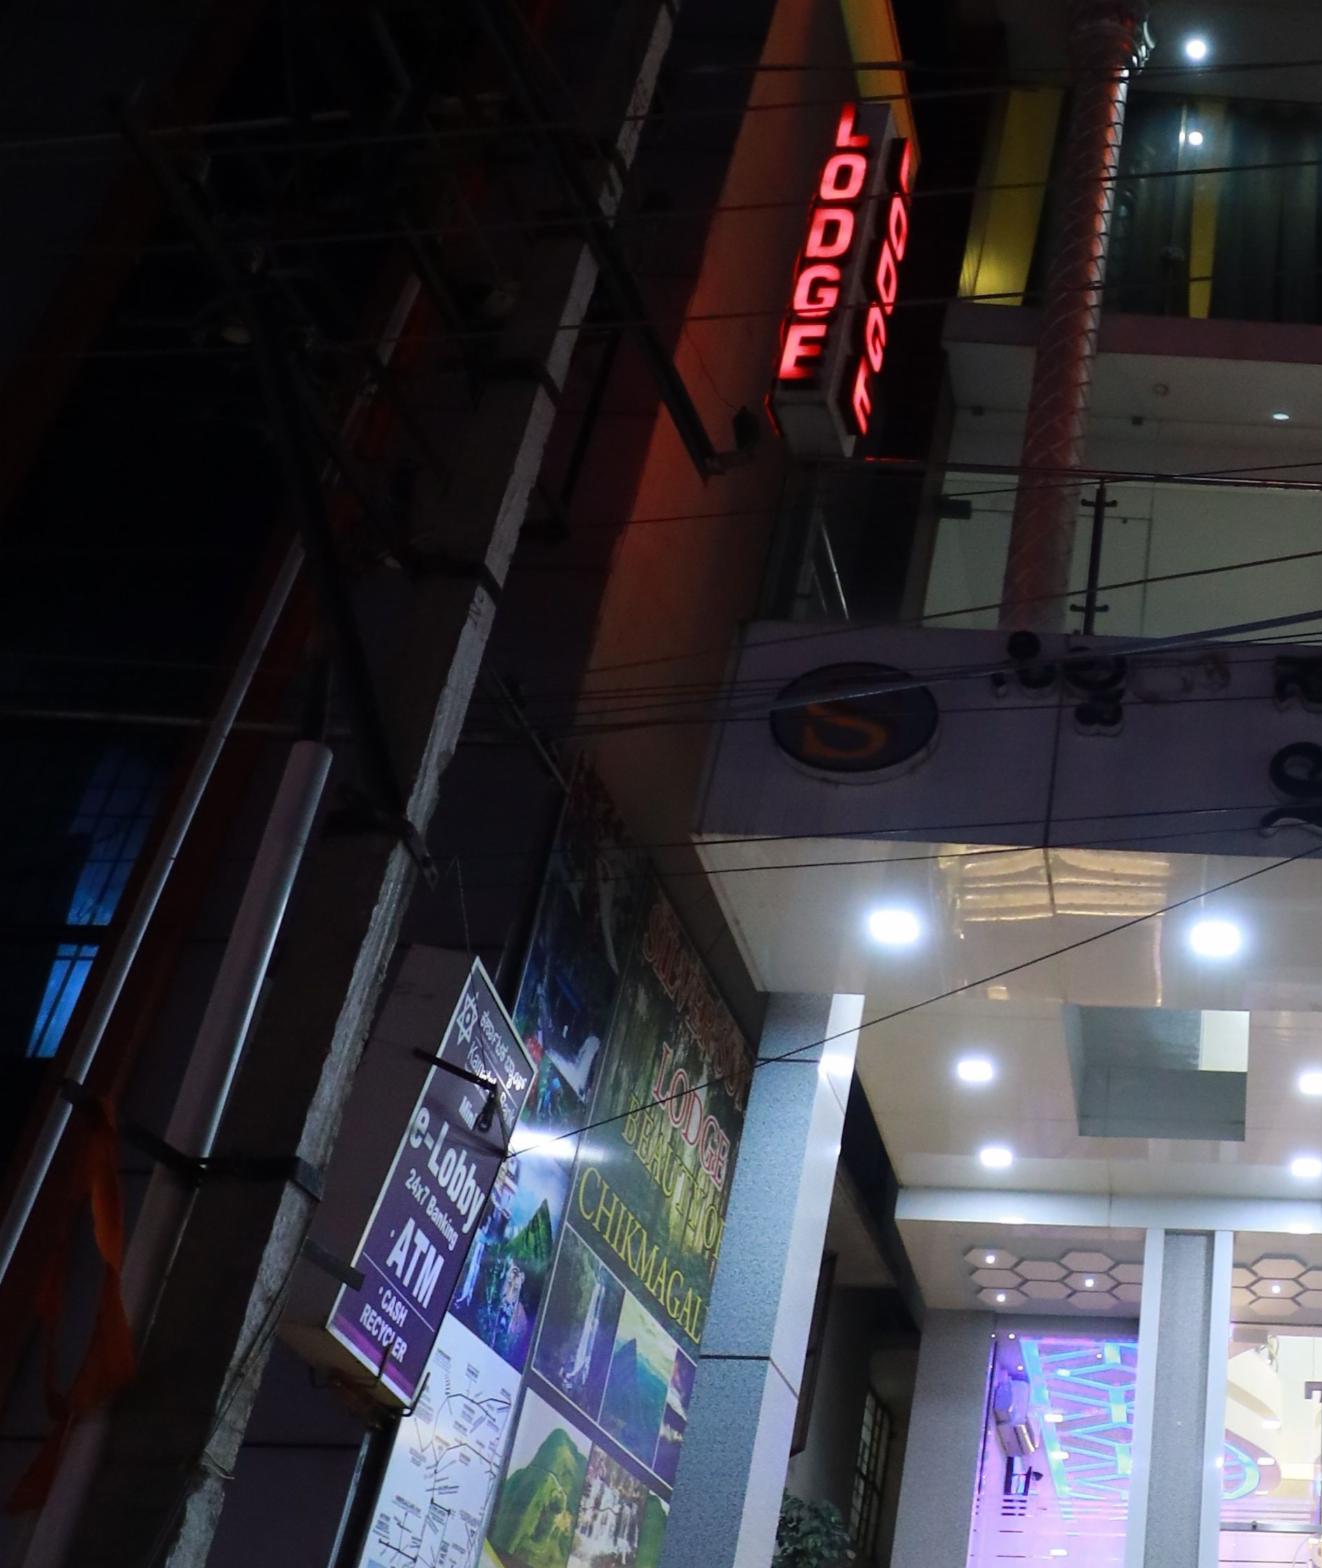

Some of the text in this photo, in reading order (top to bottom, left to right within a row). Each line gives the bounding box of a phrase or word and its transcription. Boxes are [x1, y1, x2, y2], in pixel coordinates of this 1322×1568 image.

[778, 101, 870, 381] LODGE
[407, 1104, 485, 1234] e-Lobby
[649, 1039, 731, 1193] LODGE
[395, 1215, 446, 1311] ATM
[405, 1167, 459, 1252] 24x7 Banking
[578, 1165, 703, 1345] CHIKMAGAL
[380, 1289, 408, 1327] CASH
